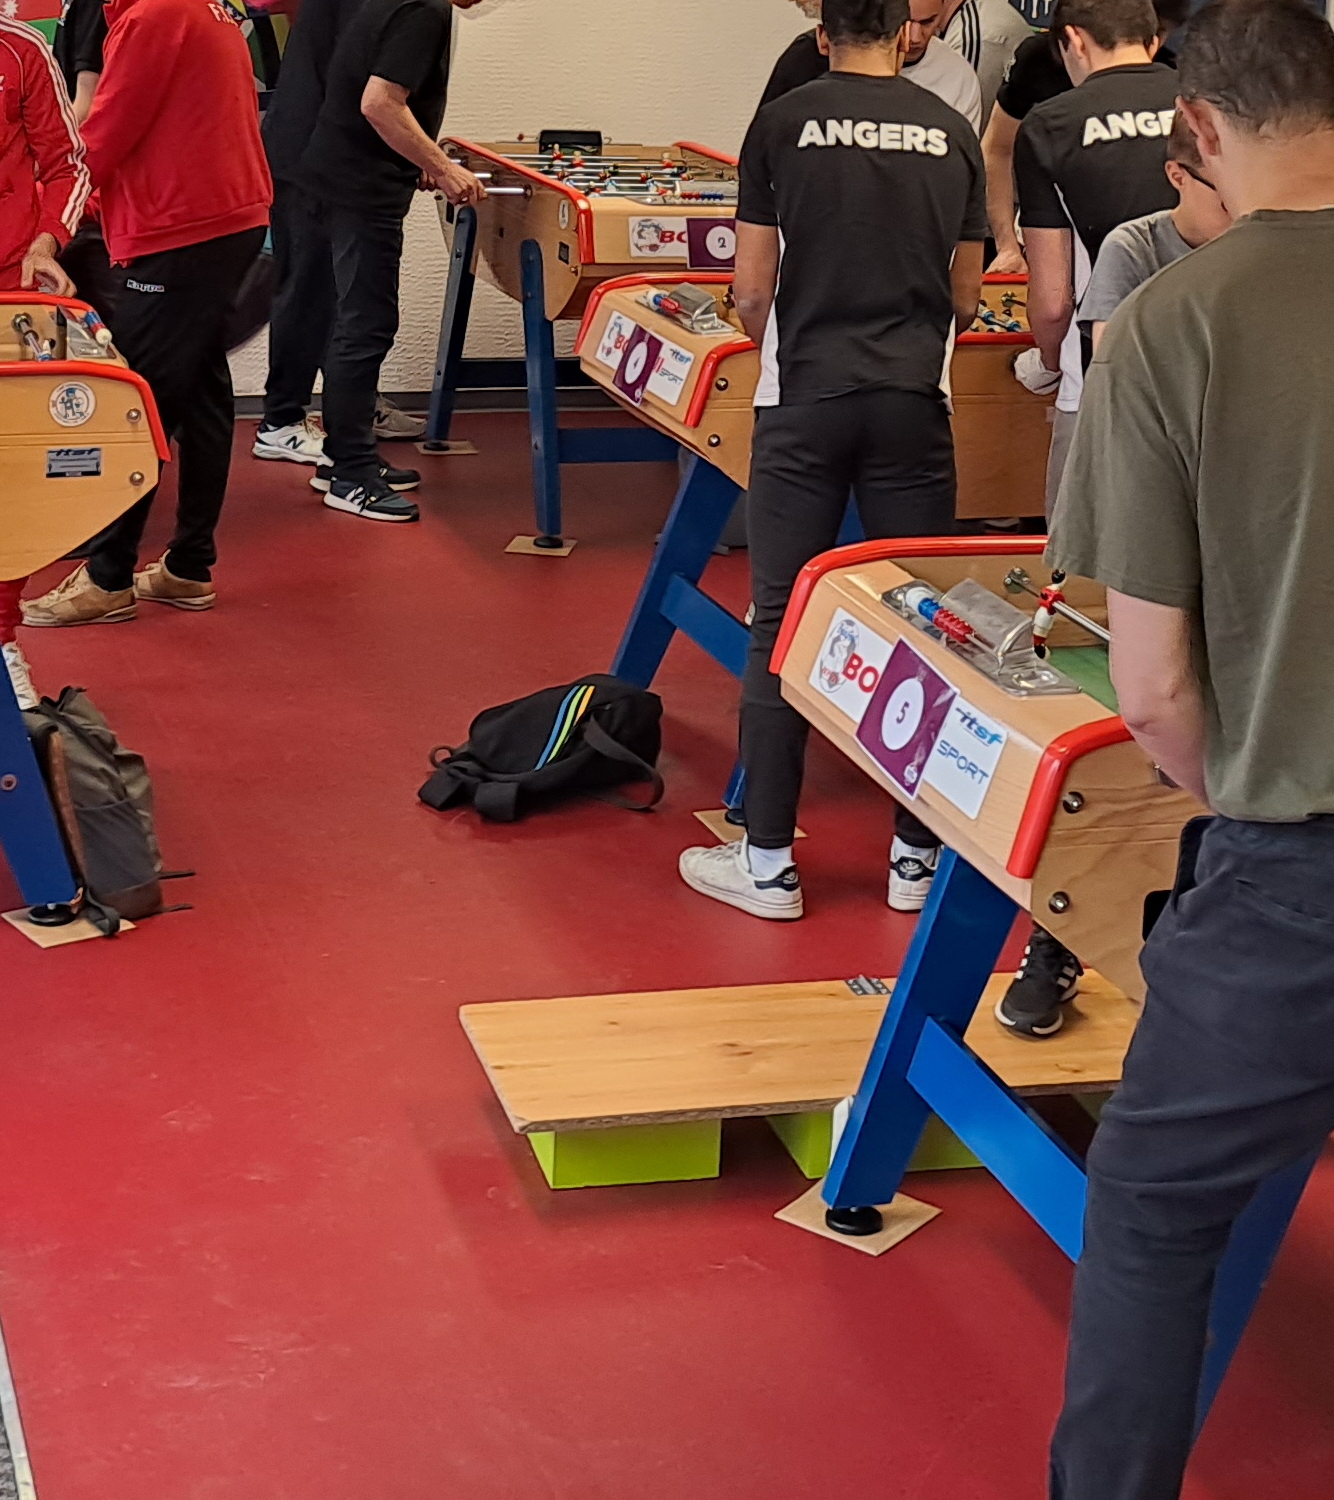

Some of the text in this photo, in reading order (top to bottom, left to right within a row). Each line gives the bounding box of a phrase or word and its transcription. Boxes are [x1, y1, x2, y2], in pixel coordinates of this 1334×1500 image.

[797, 119, 948, 157] ANGERS
[718, 237, 727, 248] 2
[896, 701, 910, 725] 5
[936, 739, 990, 785] SPORT
